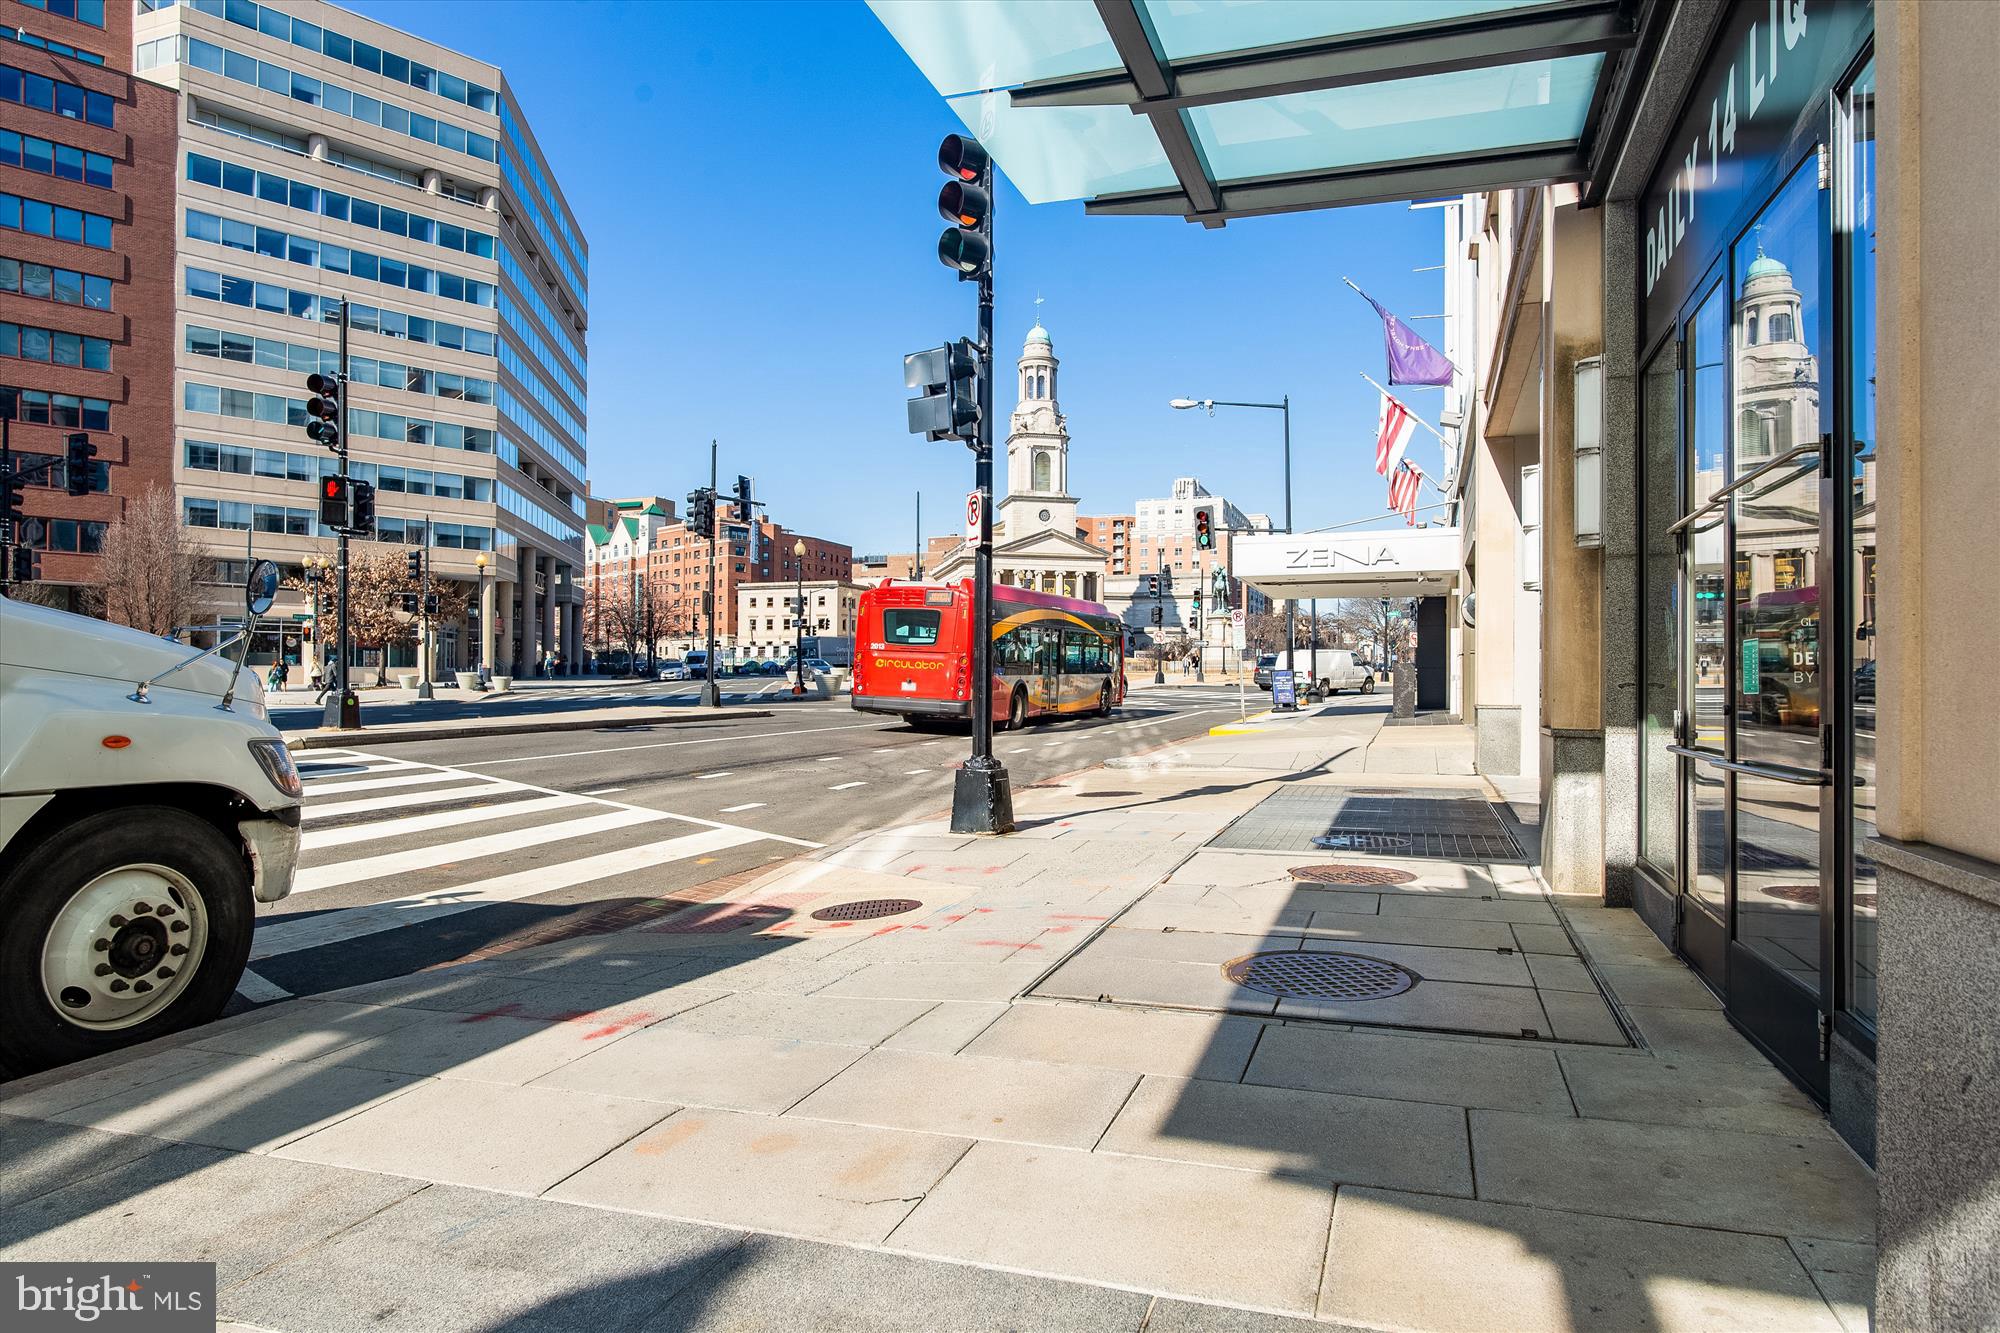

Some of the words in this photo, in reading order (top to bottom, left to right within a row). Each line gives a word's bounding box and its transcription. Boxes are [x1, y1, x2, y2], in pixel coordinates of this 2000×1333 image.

[1646, 136, 1699, 298] DAILY
[1708, 63, 1737, 185] 14
[1286, 545, 1400, 569] ZENA
[1793, 670, 1815, 684] BY
